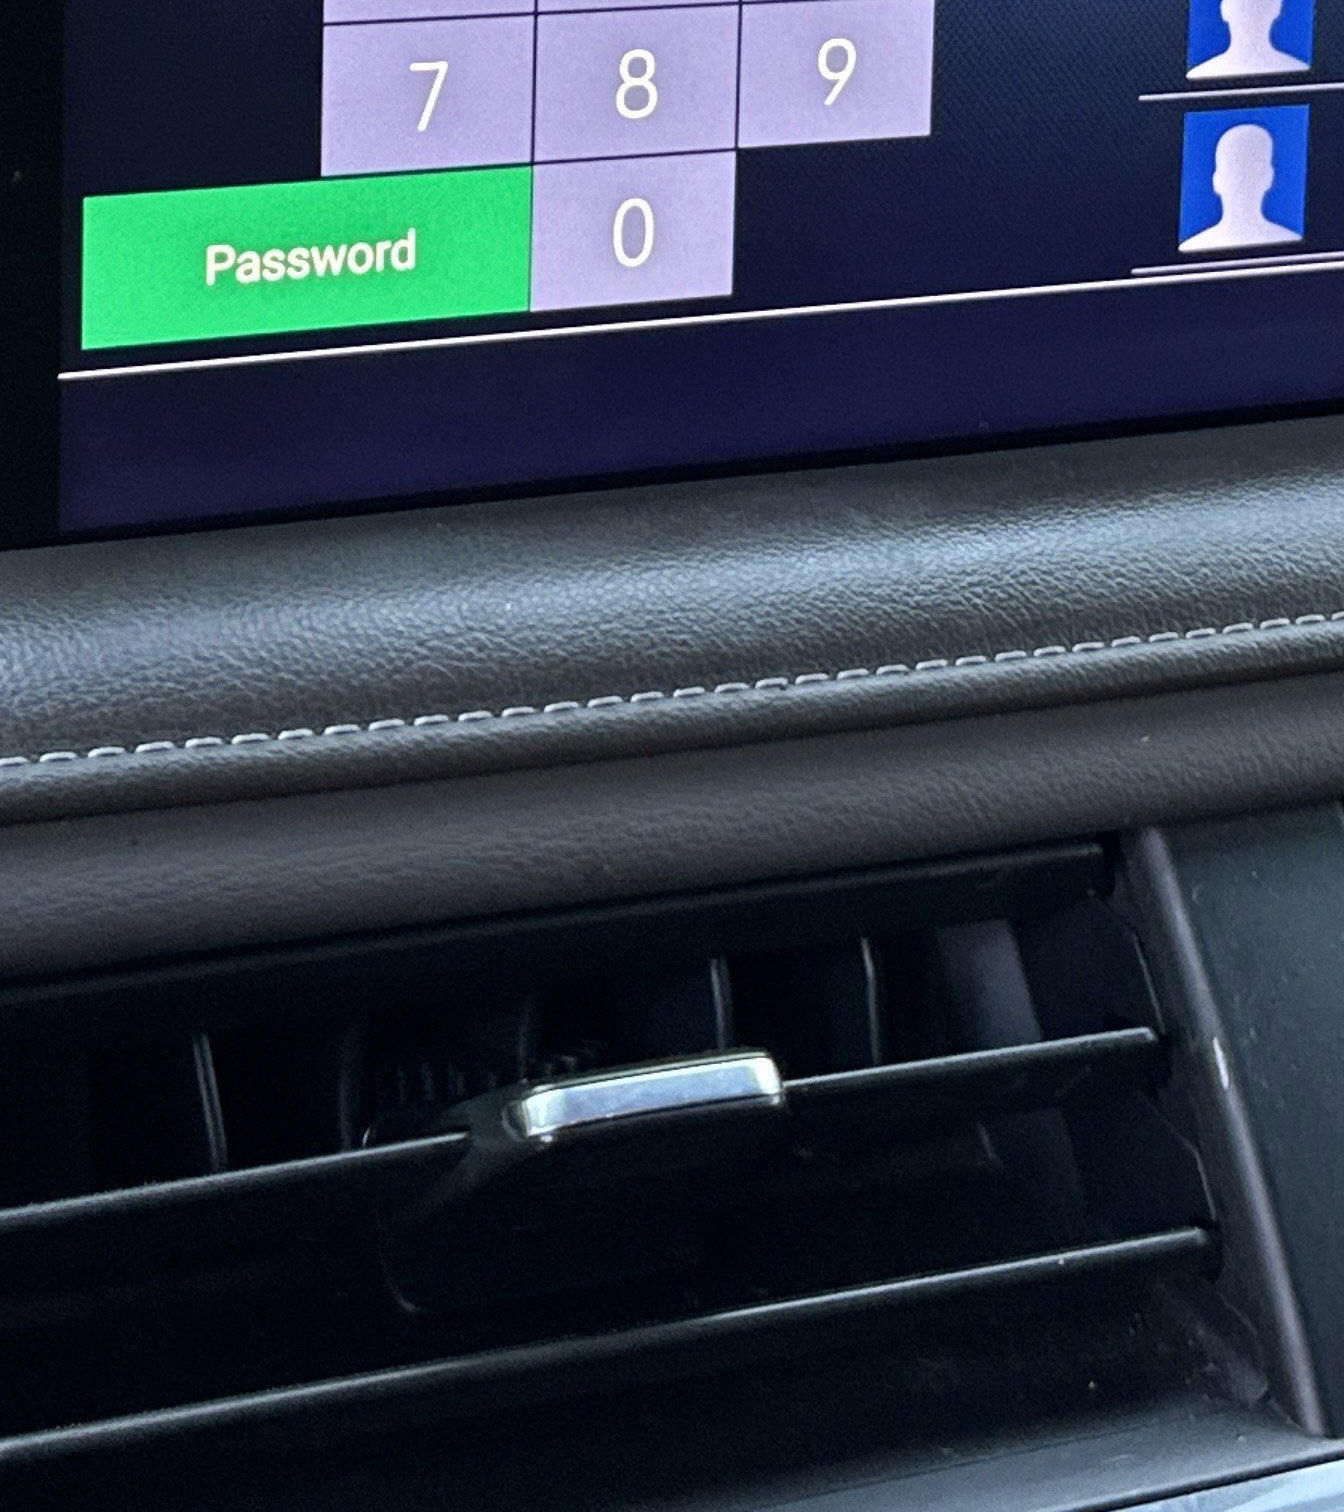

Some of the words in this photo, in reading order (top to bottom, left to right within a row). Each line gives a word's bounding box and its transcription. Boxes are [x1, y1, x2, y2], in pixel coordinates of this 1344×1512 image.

[408, 59, 450, 133] 7
[614, 47, 659, 120] 8
[816, 37, 858, 107] 9
[204, 226, 418, 287] Password
[612, 196, 655, 269] 0
